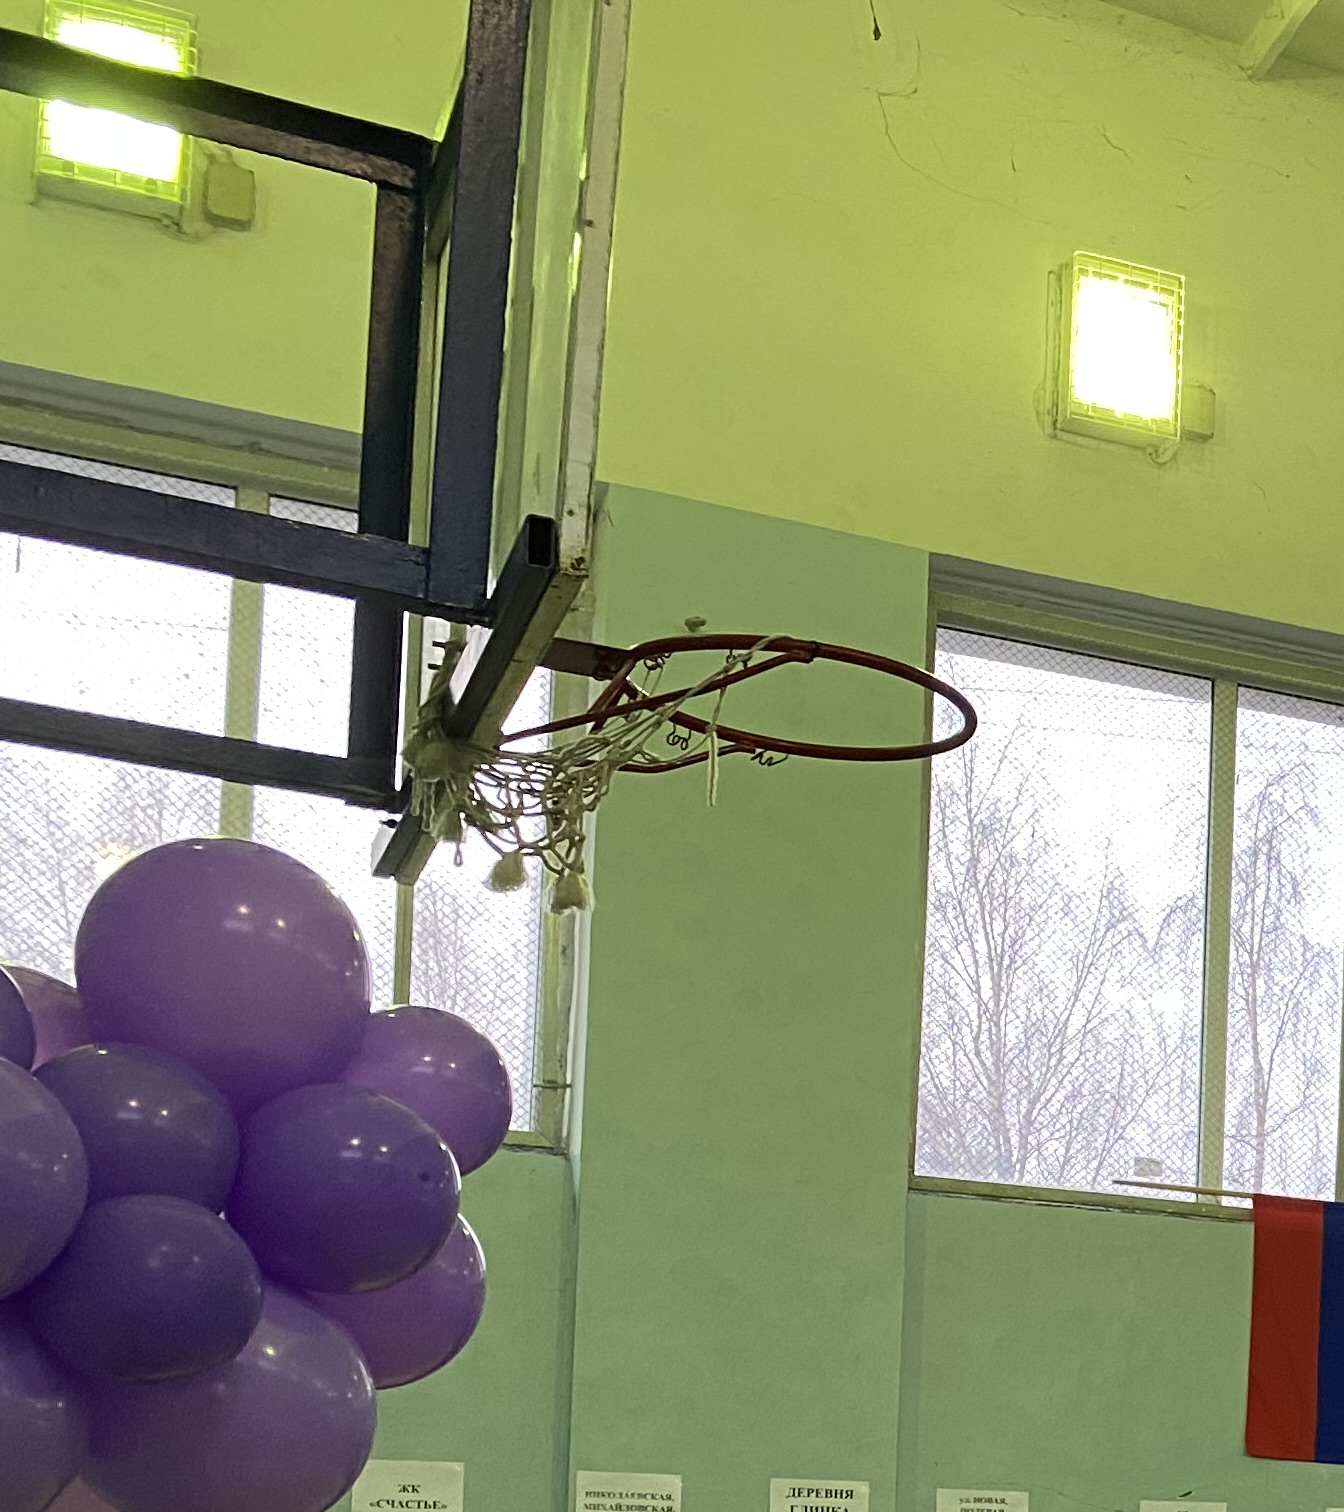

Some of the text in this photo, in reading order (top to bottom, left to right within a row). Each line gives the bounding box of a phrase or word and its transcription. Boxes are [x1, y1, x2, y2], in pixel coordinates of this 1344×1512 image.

[397, 1483, 421, 1494] ЖК
[785, 1487, 854, 1499] ДЕРЕВНЯ
[369, 1498, 448, 1510] «СЧАСТЬЕ»
